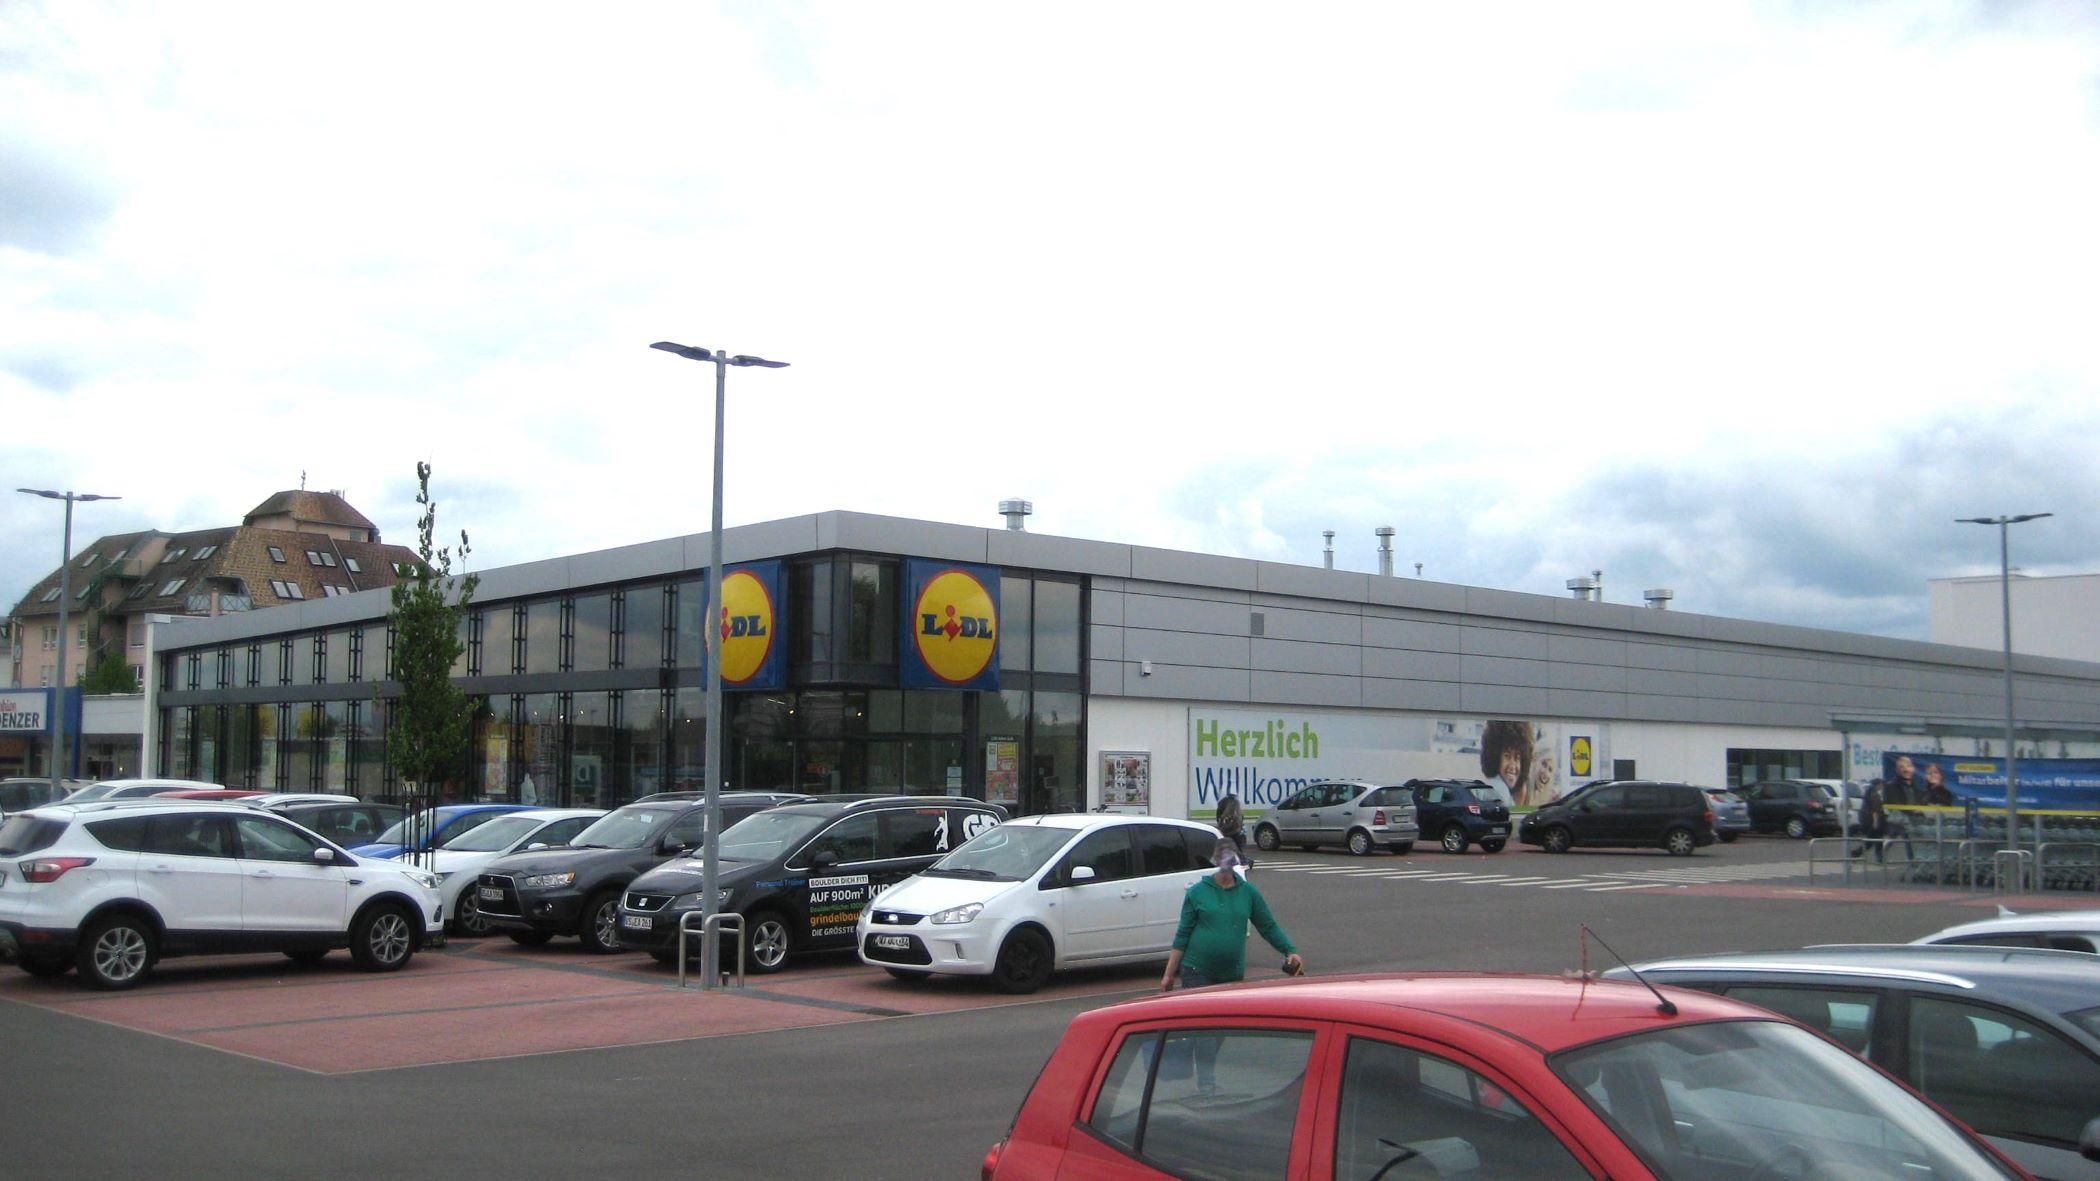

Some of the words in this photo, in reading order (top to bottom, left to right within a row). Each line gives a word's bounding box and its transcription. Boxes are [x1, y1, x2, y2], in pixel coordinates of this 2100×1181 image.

[720, 607, 767, 643] IDL
[0, 712, 40, 728] ENZER
[1196, 718, 1319, 758] Herzlich
[1195, 767, 1363, 805] Willkom
[811, 878, 840, 887] BOULDER
[810, 891, 829, 903] AUF
[811, 928, 823, 937] DIE
